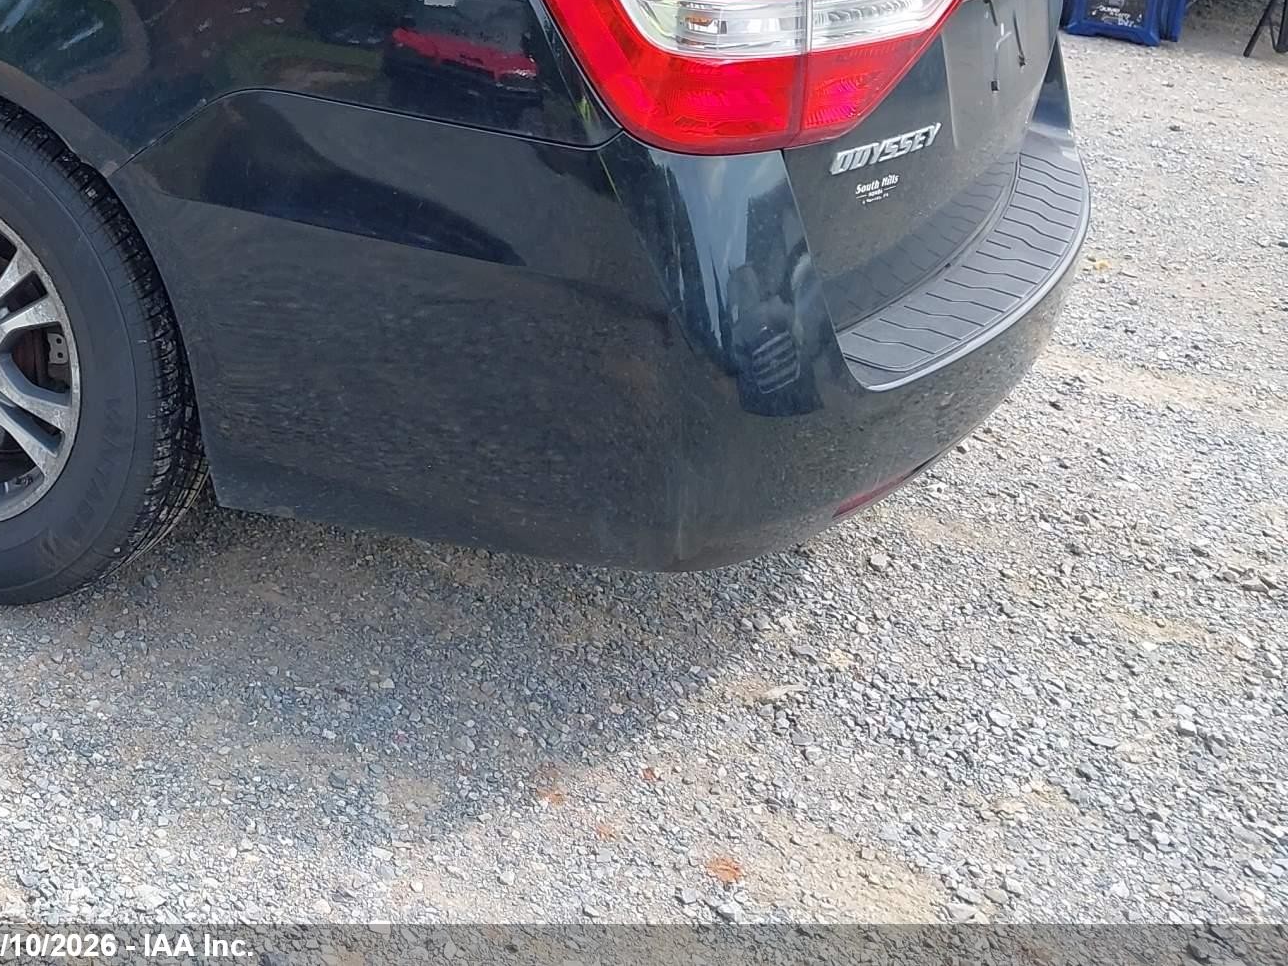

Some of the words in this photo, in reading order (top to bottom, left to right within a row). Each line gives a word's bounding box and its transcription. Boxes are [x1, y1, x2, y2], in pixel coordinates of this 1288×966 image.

[830, 122, 942, 175] ODYSSEY
[855, 180, 880, 194] South
[881, 174, 899, 186] Hills
